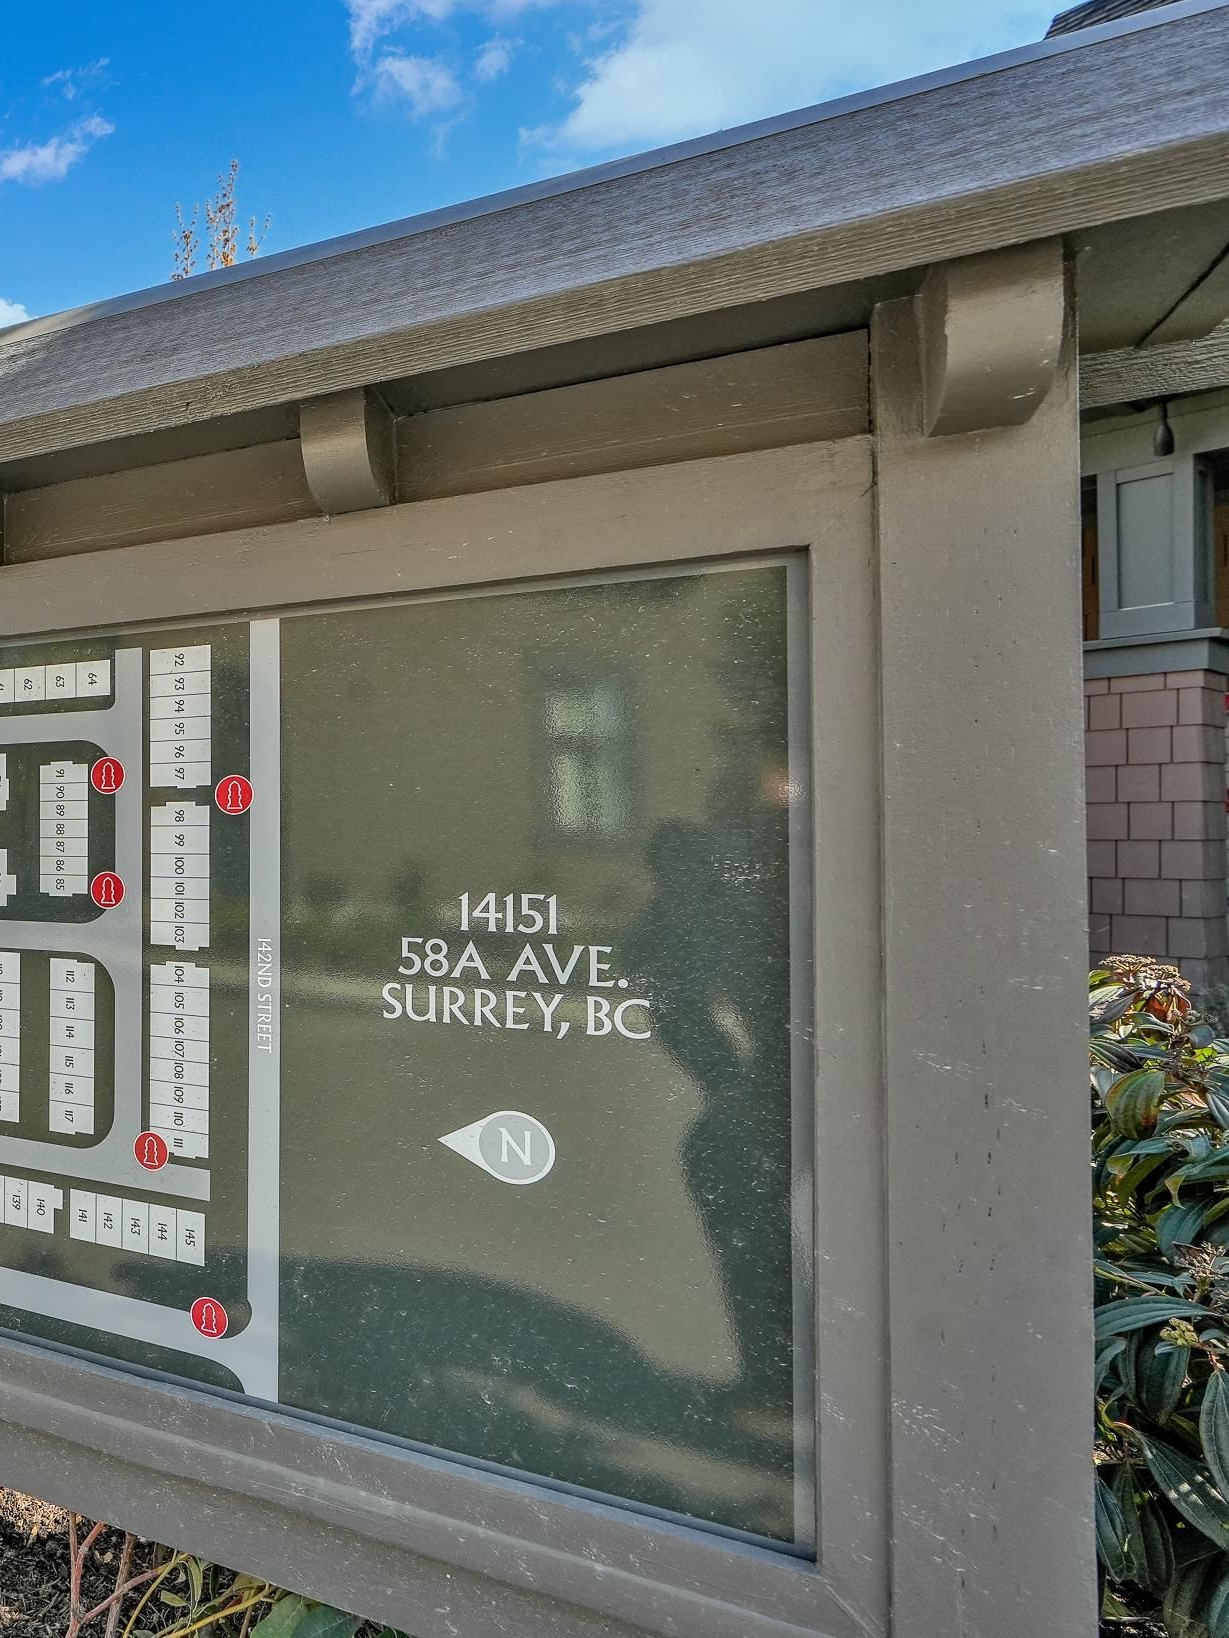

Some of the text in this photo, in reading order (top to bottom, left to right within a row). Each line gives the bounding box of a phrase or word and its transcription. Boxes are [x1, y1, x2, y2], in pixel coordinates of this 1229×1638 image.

[174, 653, 185, 667] 92
[23, 678, 33, 691] 62
[55, 675, 65, 688] 63
[87, 672, 98, 685] 64
[174, 677, 185, 691] 93
[174, 699, 185, 713] 94
[174, 722, 185, 735] 95
[174, 745, 185, 759] 96
[55, 768, 65, 778] 91
[174, 767, 185, 780] 97
[55, 785, 65, 799] 90
[55, 804, 65, 817] 89
[174, 809, 185, 823] 98
[55, 823, 65, 836] 88
[55, 840, 65, 853] 87
[174, 833, 185, 847] 99
[55, 859, 65, 872] 86
[174, 857, 185, 875] 100
[55, 878, 65, 891] 85
[174, 882, 185, 896] 101
[174, 901, 185, 919] 102
[458, 891, 558, 935] 14151
[174, 925, 185, 944] 103
[397, 936, 630, 989] 58A AVE.
[65, 970, 75, 983] 112
[174, 965, 185, 984] 104
[174, 991, 185, 1009] 105
[257, 938, 272, 1054] 142ND STREET
[65, 997, 75, 1011] 113
[381, 982, 653, 1040] SURREY, BC
[65, 1025, 75, 1039] 114
[174, 1017, 185, 1035] 106
[173, 1040, 185, 1058] 107
[64, 1055, 74, 1069] 115
[173, 1062, 184, 1080] 108
[64, 1082, 74, 1095] 116
[173, 1086, 184, 1104] 109
[64, 1110, 74, 1123] 117
[173, 1111, 184, 1126] 110
[173, 1137, 183, 1148] 111
[498, 1127, 533, 1167] N
[12, 1194, 21, 1211] 139
[36, 1198, 46, 1216] 140
[78, 1208, 88, 1223] 141
[103, 1212, 113, 1230] 142
[130, 1217, 141, 1236] 143
[157, 1222, 168, 1241] 144
[185, 1228, 196, 1247] 145
